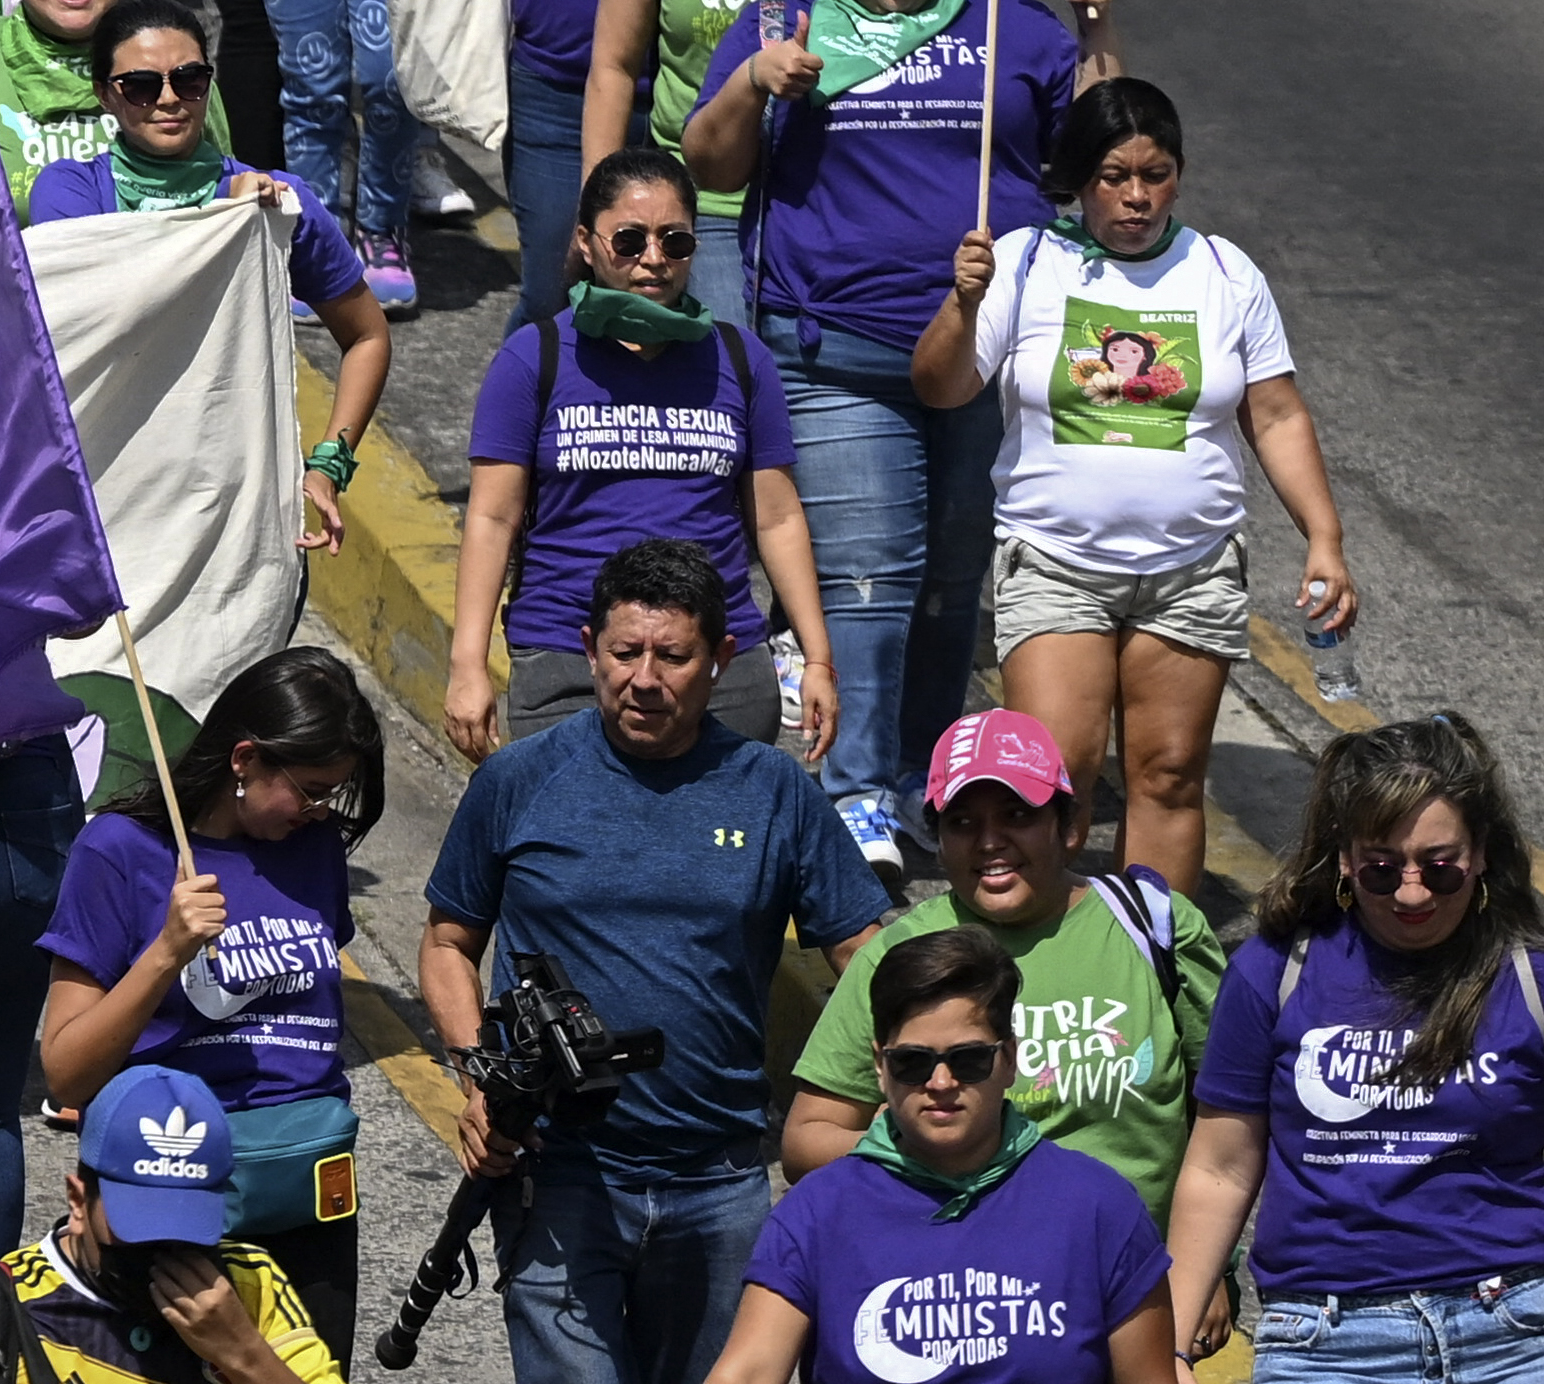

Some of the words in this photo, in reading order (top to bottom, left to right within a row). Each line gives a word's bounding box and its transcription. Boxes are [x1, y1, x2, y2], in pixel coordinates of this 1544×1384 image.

[1139, 312, 1197, 323] BEATRIZ
[557, 405, 661, 432] VIOLENCIA
[666, 407, 737, 436] SEXUAL
[557, 430, 572, 446] UN
[575, 430, 620, 446] CRIMEN
[622, 431, 638, 445] DE
[640, 431, 669, 447] LESA
[673, 432, 737, 452] HUMANIDAD
[556, 445, 734, 477] #MozoteNuncaMás
[220, 926, 243, 948] POR
[260, 916, 293, 942] POR
[291, 919, 313, 936] MI
[270, 971, 314, 996] TODAS
[1342, 1030, 1373, 1049] POR
[1052, 1056, 1147, 1119] VIVIR
[1350, 1083, 1379, 1108] POR
[1385, 1085, 1434, 1111] TODAS
[133, 1156, 209, 1181] adidas
[903, 1278, 935, 1301] POR
[965, 1268, 998, 1297] POR
[1000, 1276, 1024, 1298] MI
[921, 1339, 955, 1364] POR
[956, 1336, 1010, 1365] TODAS
